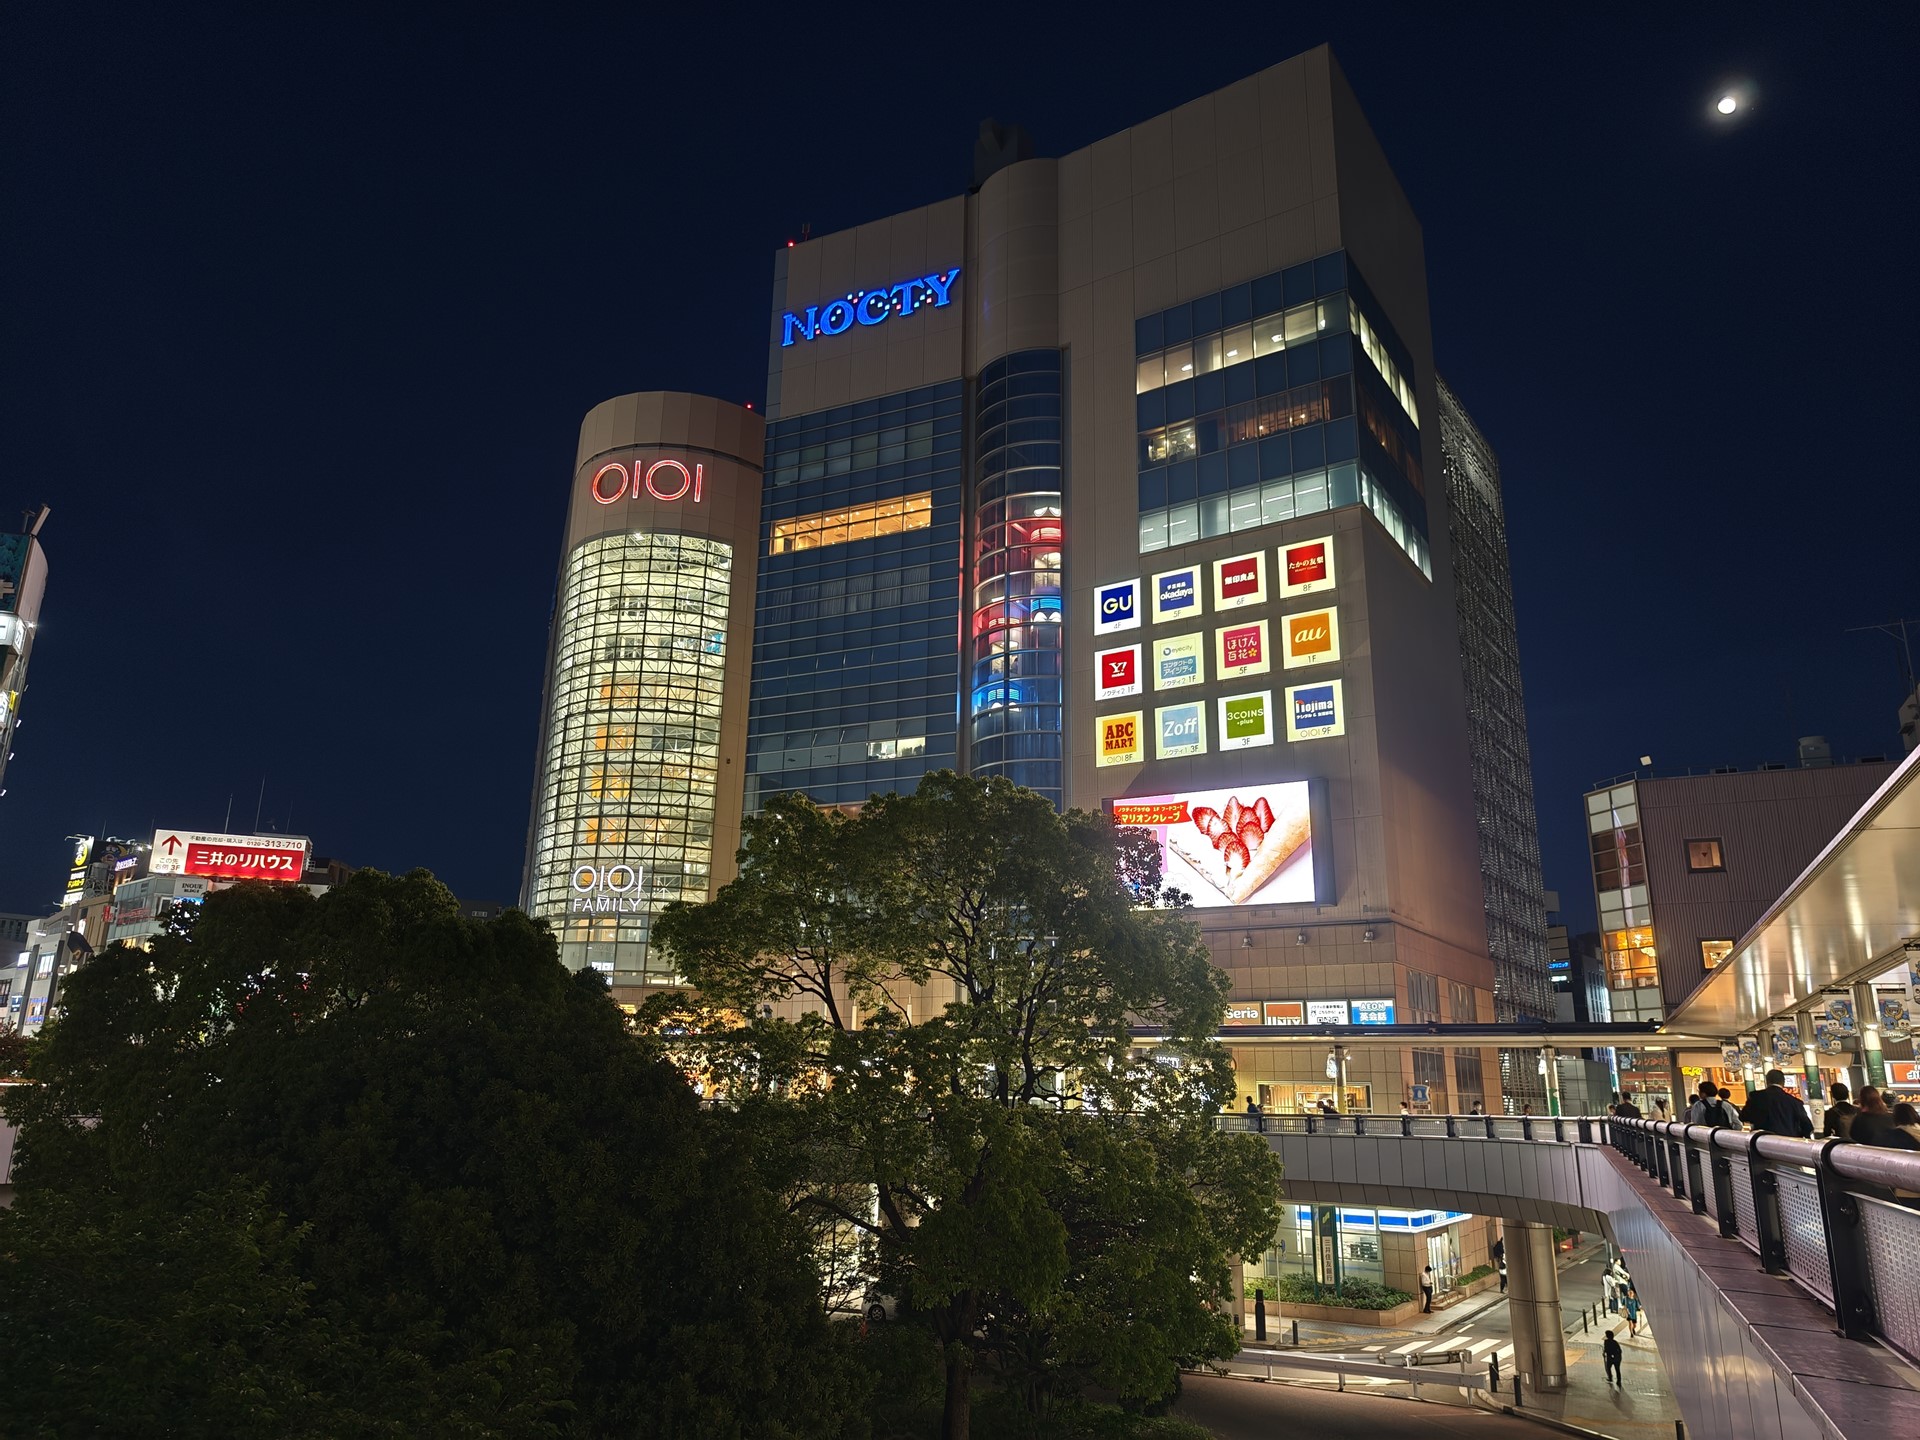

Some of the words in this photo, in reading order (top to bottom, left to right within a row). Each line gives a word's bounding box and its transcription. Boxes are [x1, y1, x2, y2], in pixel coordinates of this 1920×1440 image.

[782, 268, 960, 346] NOCTY
[1302, 583, 1312, 592] 8F
[1160, 588, 1193, 601] okadaya
[1103, 594, 1132, 615] GU
[1236, 597, 1245, 606] 6F
[1173, 610, 1182, 618] 5F
[1294, 626, 1327, 643] au
[1227, 636, 1257, 650] ほけん
[1228, 648, 1248, 661] 百花
[1307, 654, 1316, 663] 1F
[1108, 661, 1127, 674] Y!
[1238, 666, 1248, 674] 5F
[1188, 675, 1197, 683] 1F
[1127, 685, 1135, 693] 1F
[1295, 699, 1333, 713] nojima
[1227, 708, 1264, 721] 3COINS
[1105, 722, 1133, 740] ABC
[1163, 717, 1198, 737] Zoff
[1321, 727, 1331, 735] 9F
[1105, 737, 1134, 750] MART
[1241, 738, 1250, 746] 3F
[1190, 745, 1199, 753] 3F
[1124, 754, 1133, 762] 8F
[246, 839, 303, 850] 0120-313-710
[194, 850, 294, 871] 三井のリハウス
[573, 897, 642, 913] FAMILY
[1360, 1002, 1387, 1011] AEON
[1226, 1007, 1259, 1019] Seria
[1359, 1011, 1387, 1021] 英会話
[1324, 1239, 1333, 1282] 三井住友銀行
